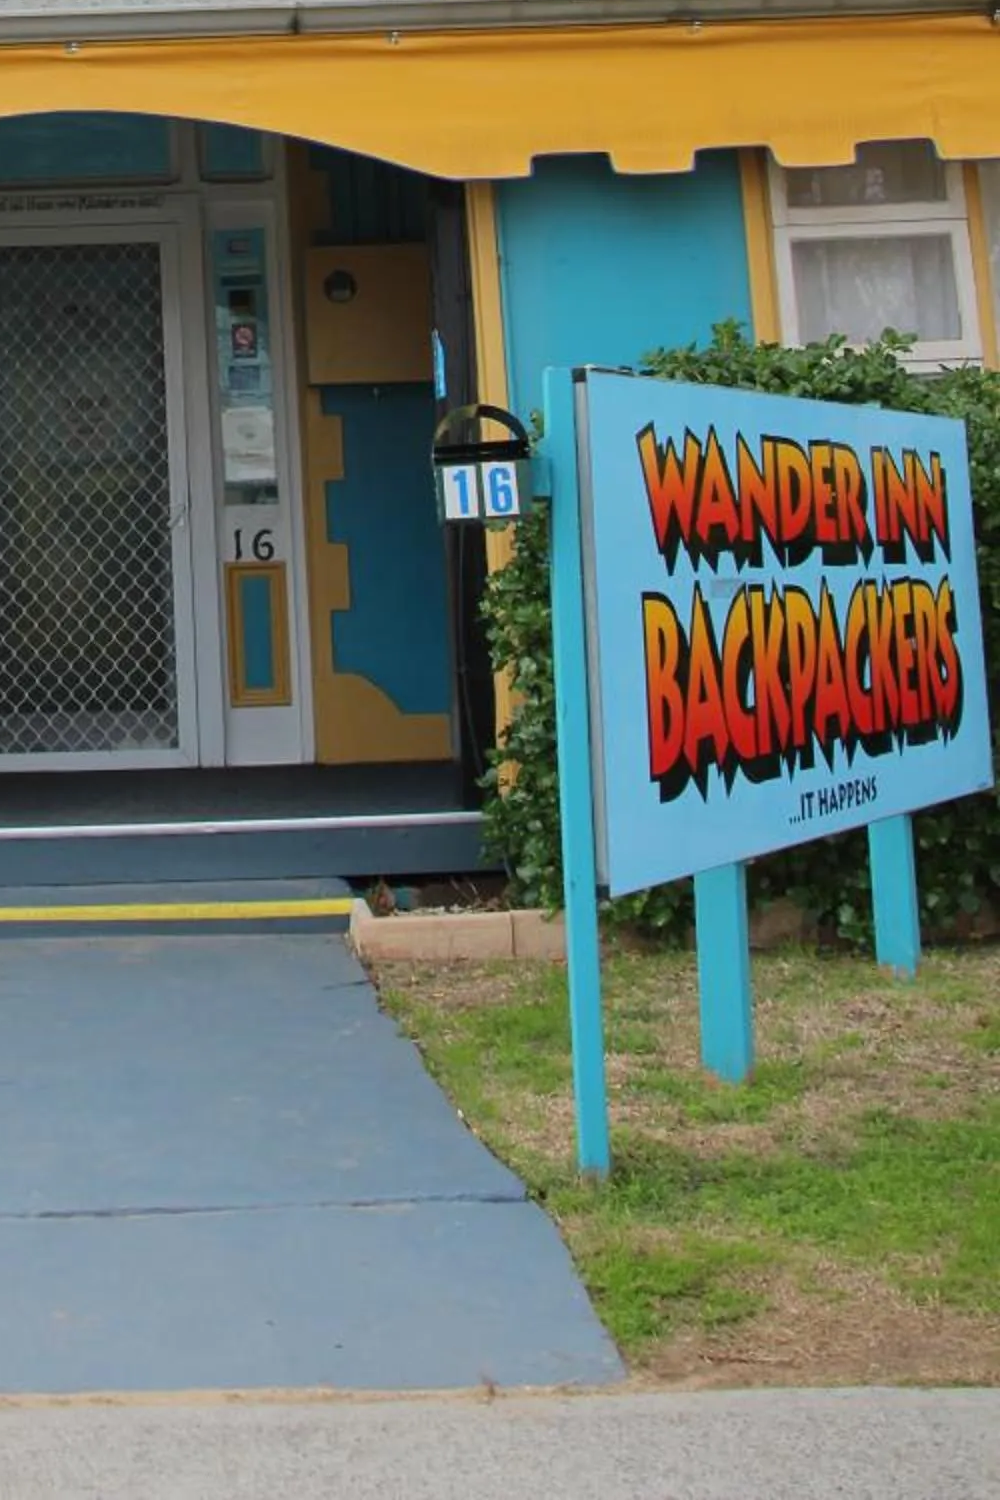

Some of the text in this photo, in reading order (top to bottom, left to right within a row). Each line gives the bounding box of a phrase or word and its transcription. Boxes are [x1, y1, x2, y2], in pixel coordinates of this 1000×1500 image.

[452, 467, 514, 516] 16
[636, 421, 952, 577] WANDER INN
[234, 528, 275, 561] 16
[641, 573, 964, 804] BACKPACKERS
[817, 775, 878, 817] HAPPENS
